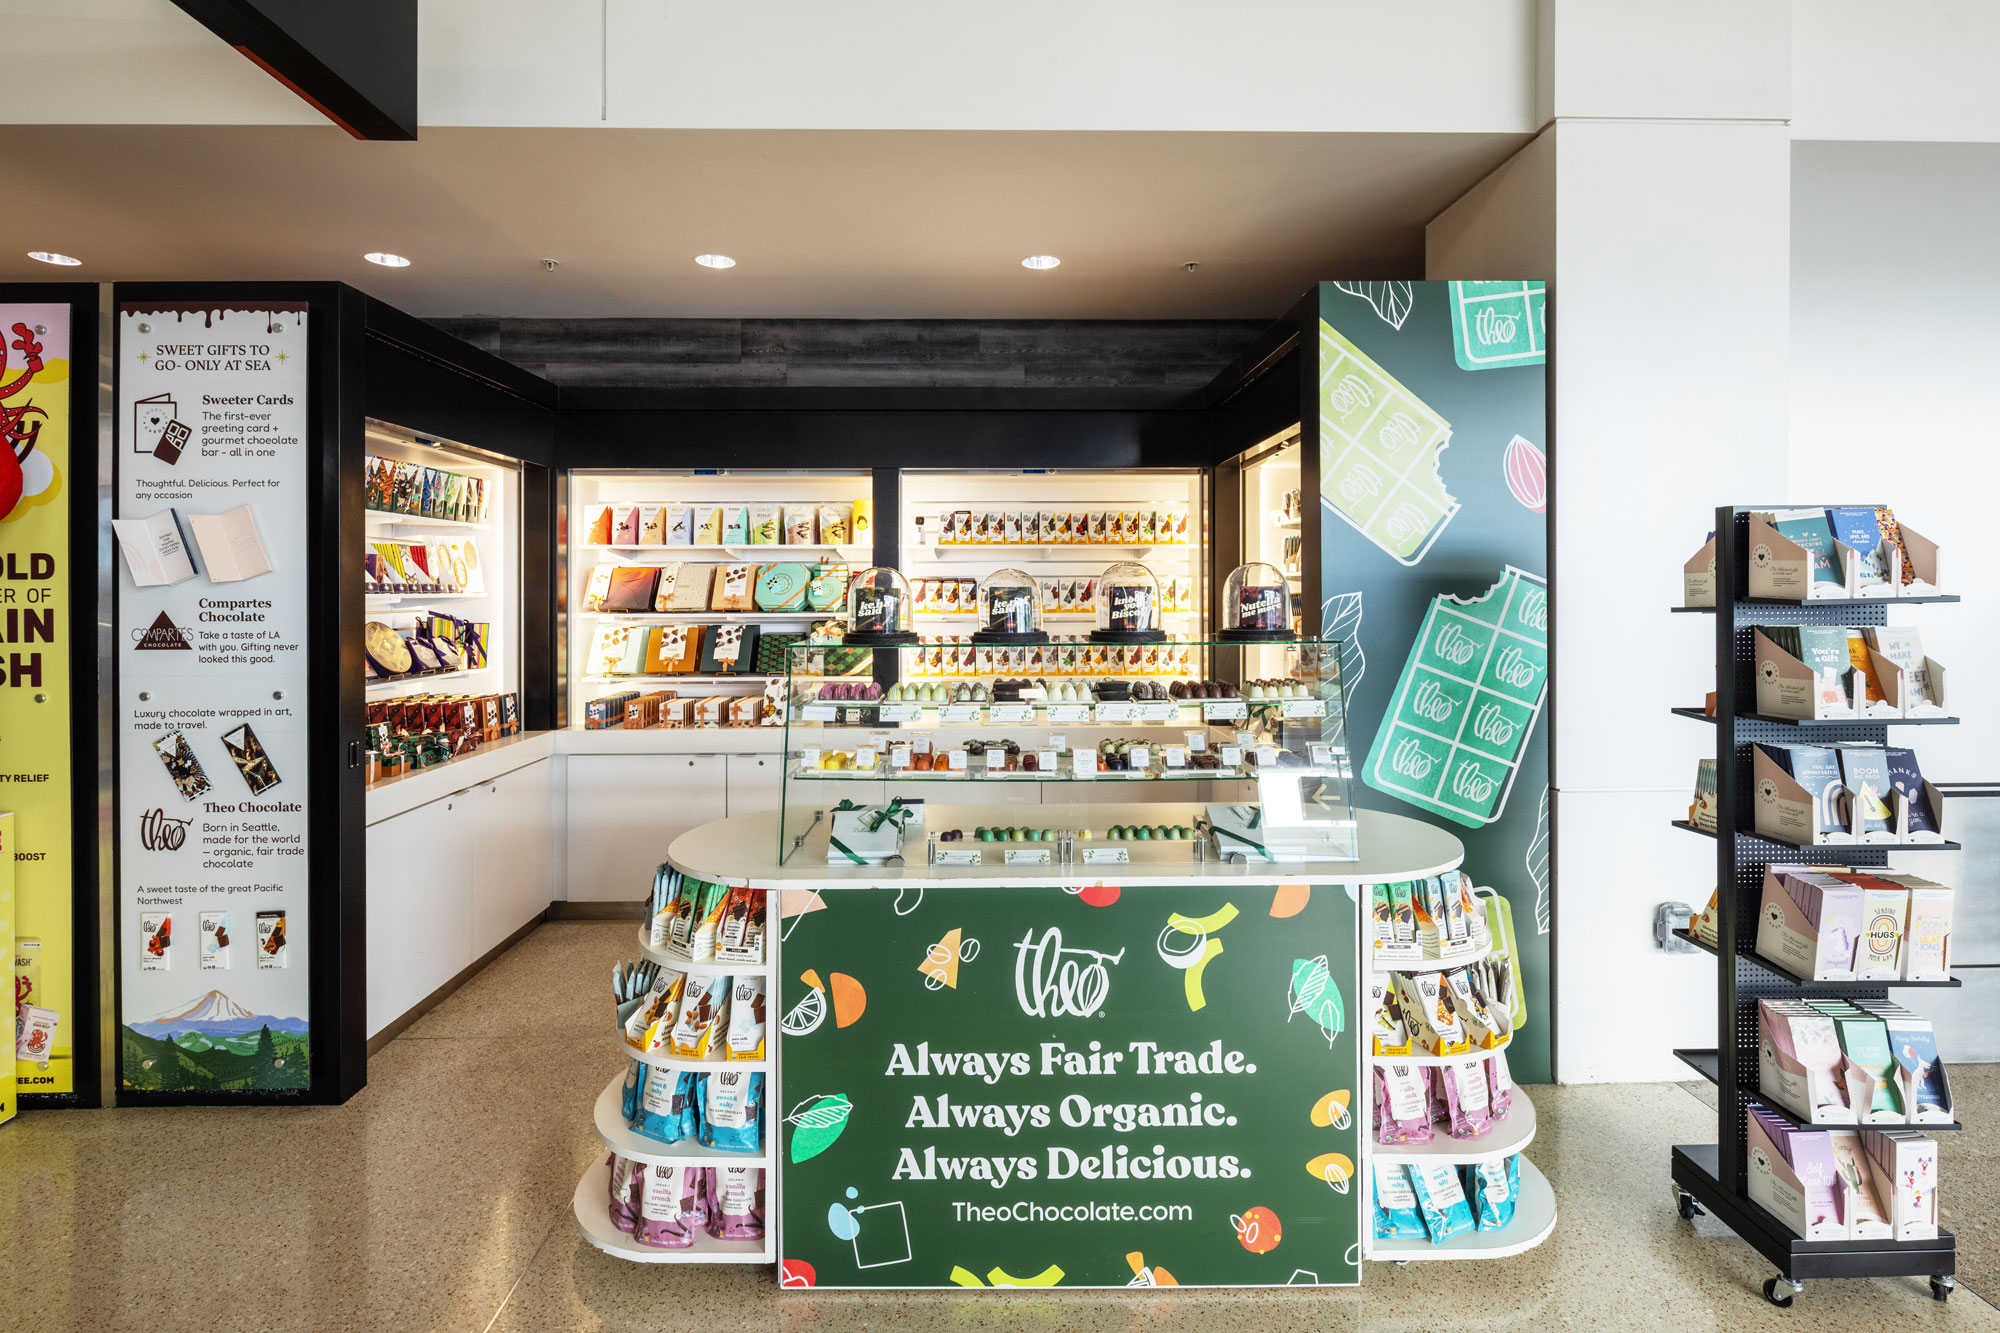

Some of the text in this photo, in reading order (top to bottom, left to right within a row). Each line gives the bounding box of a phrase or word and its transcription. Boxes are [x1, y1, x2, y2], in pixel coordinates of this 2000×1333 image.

[1475, 307, 1521, 345] theo
[157, 345, 269, 355] SWEET GIFTS TO
[155, 360, 271, 370] GO- ONLY AT SEA
[203, 395, 293, 404] Sweeter Cards
[1330, 374, 1375, 424] theo
[202, 412, 271, 420] The first-ever
[202, 424, 243, 434] greeting
[247, 424, 269, 432] card
[202, 437, 244, 446] gourmet
[1379, 411, 1424, 460] theo
[202, 448, 218, 456] bar
[230, 448, 242, 456] all
[136, 480, 184, 489] Thoughtful.
[189, 479, 229, 487] Delicious.
[233, 479, 265, 487] Perfect
[1339, 463, 1384, 514] theo
[1386, 502, 1431, 549] theo
[0, 553, 55, 580] LD
[27, 588, 51, 603] OF
[199, 598, 271, 610] Compartes
[1241, 596, 1280, 612] Nutella
[1258, 602, 1282, 614] more
[199, 611, 264, 622] Chocolate
[0, 608, 54, 643] IN
[199, 631, 219, 639] Take
[257, 631, 266, 639] of
[199, 643, 216, 651] with
[220, 645, 238, 653] you.
[241, 643, 270, 652] Gifting
[1435, 622, 1484, 665] theo
[1888, 642, 1900, 650] WE
[199, 655, 275, 664] looked this good.
[1890, 651, 1912, 660] MAKE
[1495, 645, 1545, 688] theo
[1413, 679, 1463, 722] theo
[135, 710, 165, 719] Luxury
[169, 709, 215, 717] chocolate
[219, 708, 261, 718] wrapped
[177, 721, 207, 729] travel.
[1473, 702, 1523, 745] theo
[1392, 736, 1442, 780] theo
[14, 774, 49, 782] RELIEF
[1453, 759, 1502, 802] theo
[204, 802, 301, 812] Theo Chocolate
[140, 808, 193, 851] theo
[203, 823, 227, 832] Born
[242, 823, 279, 831] Seattle,
[203, 835, 300, 844] made for the world
[214, 846, 304, 859] organic, fair trade
[203, 859, 253, 868] chocolate
[228, 885, 251, 894] great
[1874, 907, 1896, 916] SENDING
[1920, 936, 1940, 944] ULAT
[1014, 927, 1125, 1018] theo
[686, 981, 704, 998] theo
[736, 984, 755, 1002] theo
[885, 1040, 1257, 1084] Always Fair Trade.
[720, 1102, 734, 1110] salty
[905, 1092, 1238, 1136] Always Organic.
[892, 1144, 1252, 1188] Always Delicious.
[1806, 1162, 1824, 1177] Self
[952, 1201, 1193, 1222] TheoChocolate.com
